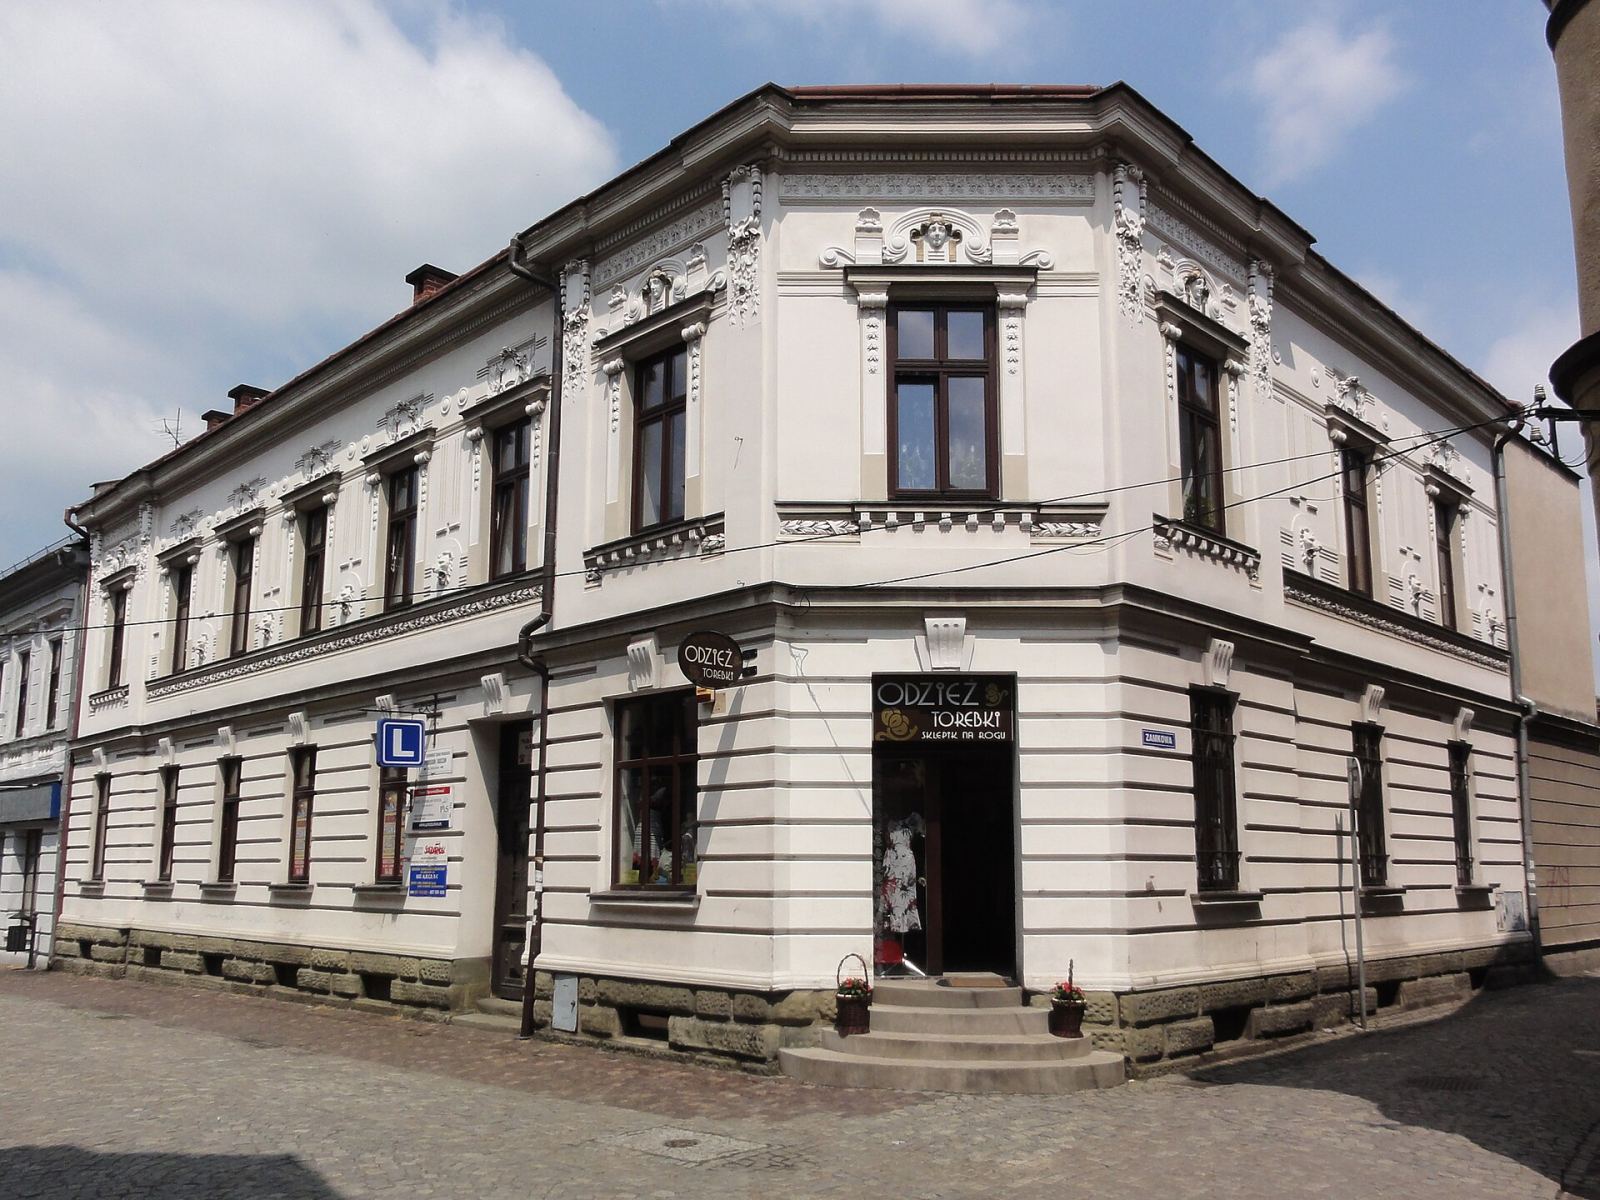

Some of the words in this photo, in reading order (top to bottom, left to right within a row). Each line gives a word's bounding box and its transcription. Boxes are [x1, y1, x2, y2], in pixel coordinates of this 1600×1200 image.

[685, 645, 734, 668] ODZIEŻ
[702, 667, 734, 680] TOREBKI
[931, 711, 1001, 728] TOREBKI
[393, 729, 414, 757] L
[921, 731, 958, 739] SKLEPIK
[962, 731, 974, 739] NA
[978, 731, 1006, 740] ROGU
[1144, 733, 1173, 745] ZAMKOWA
